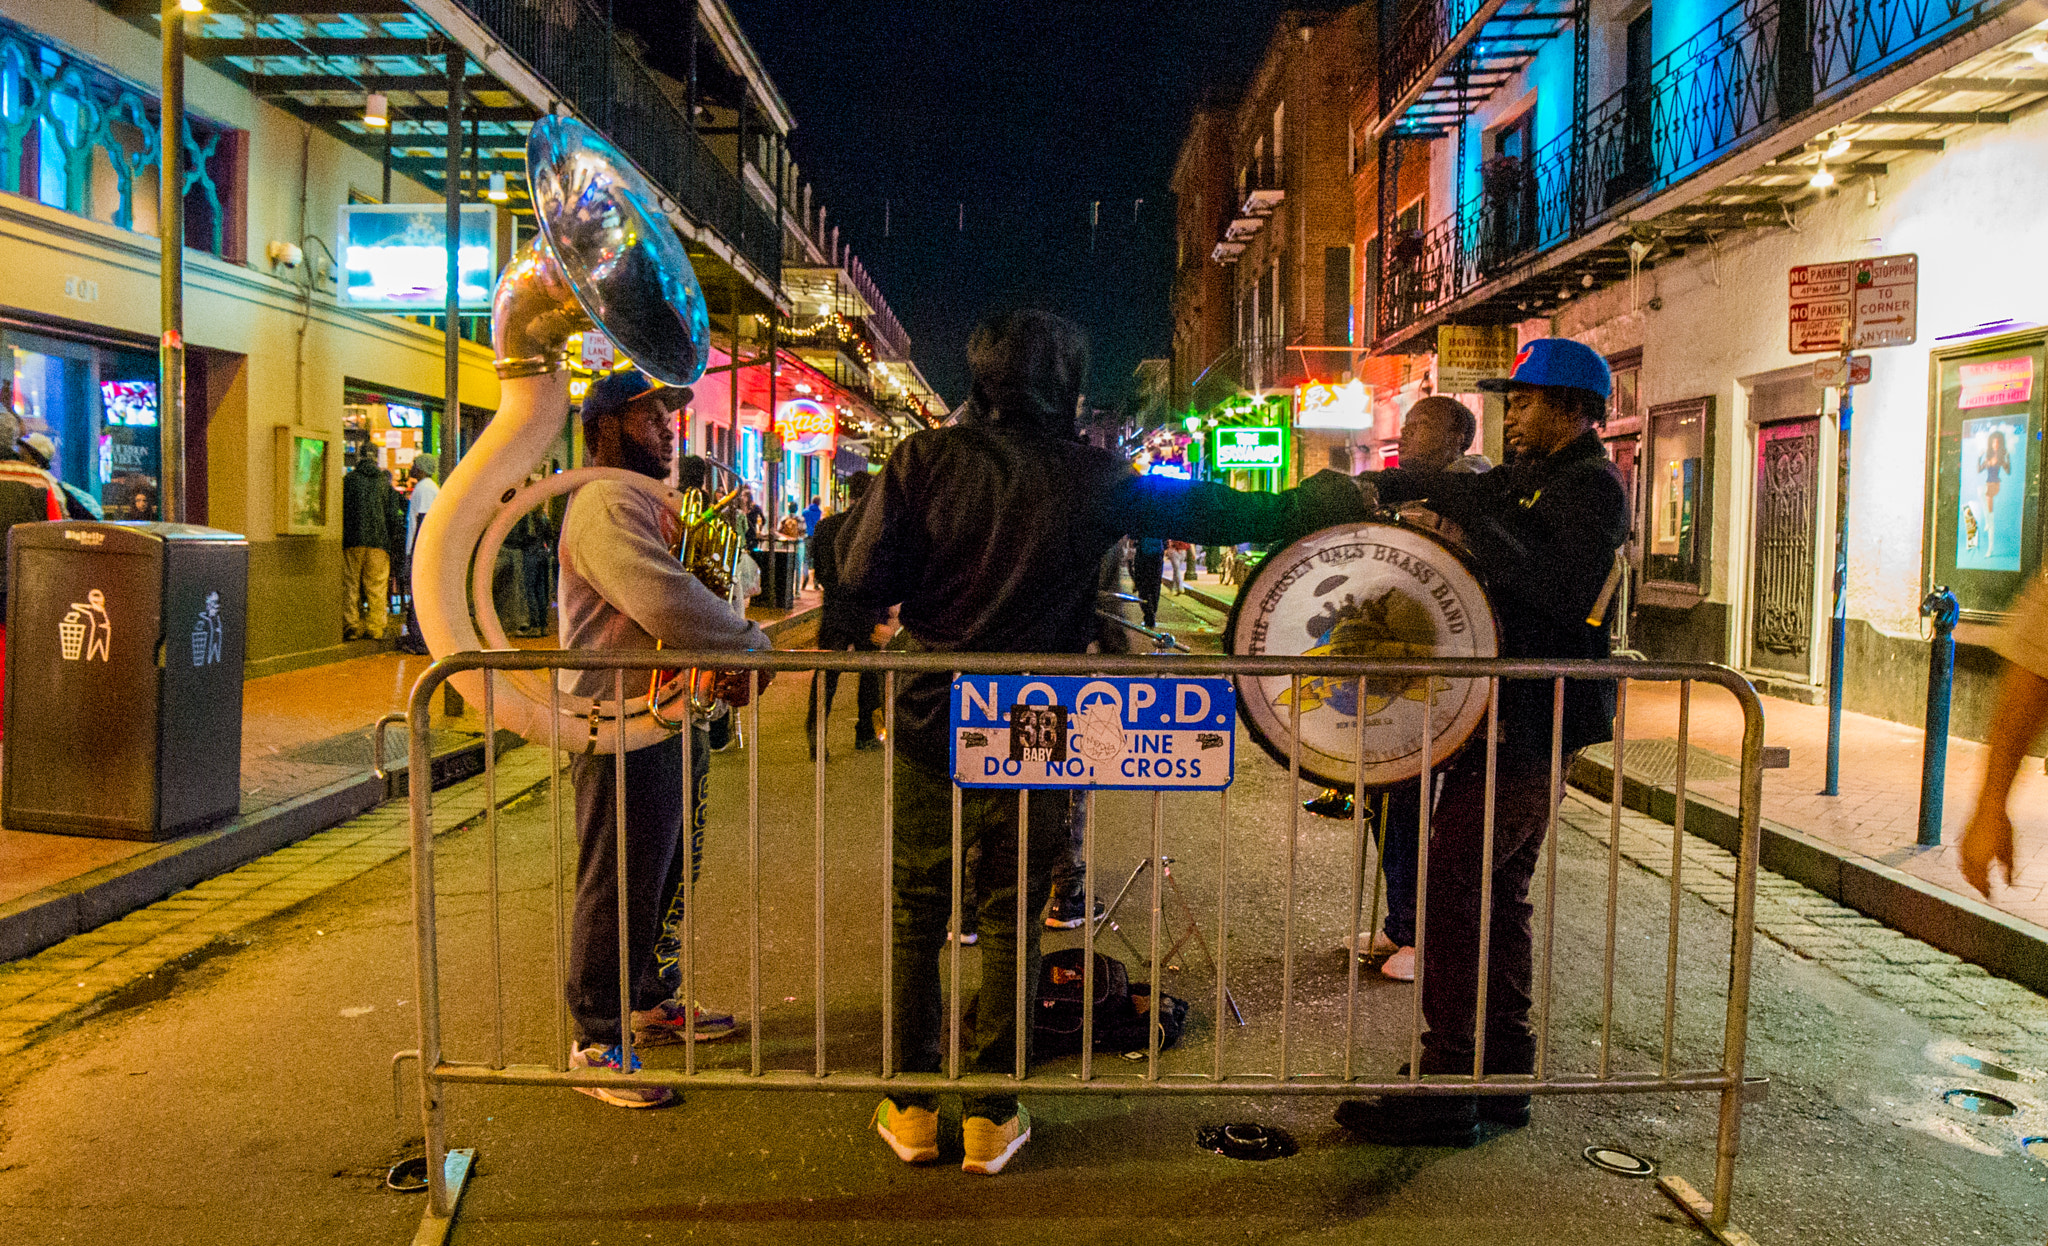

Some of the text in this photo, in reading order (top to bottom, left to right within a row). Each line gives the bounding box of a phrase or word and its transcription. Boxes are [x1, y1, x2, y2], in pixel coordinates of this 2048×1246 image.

[1791, 270, 1808, 284] NO
[1810, 265, 1848, 279] PARKING
[1878, 288, 1893, 300] TO
[1791, 303, 1848, 320] NO PARKING
[1860, 301, 1911, 315] CORNER
[589, 335, 607, 346] FIRE
[1860, 328, 1912, 341] ANYTIME
[587, 347, 608, 357] LANE
[1318, 548, 1364, 564] ONES
[1373, 545, 1435, 585] BRASS
[1430, 582, 1465, 634] BAND
[1020, 710, 1058, 748] 38
[1023, 747, 1053, 762] BABY
[984, 756, 1202, 779] DO NO CROSS
